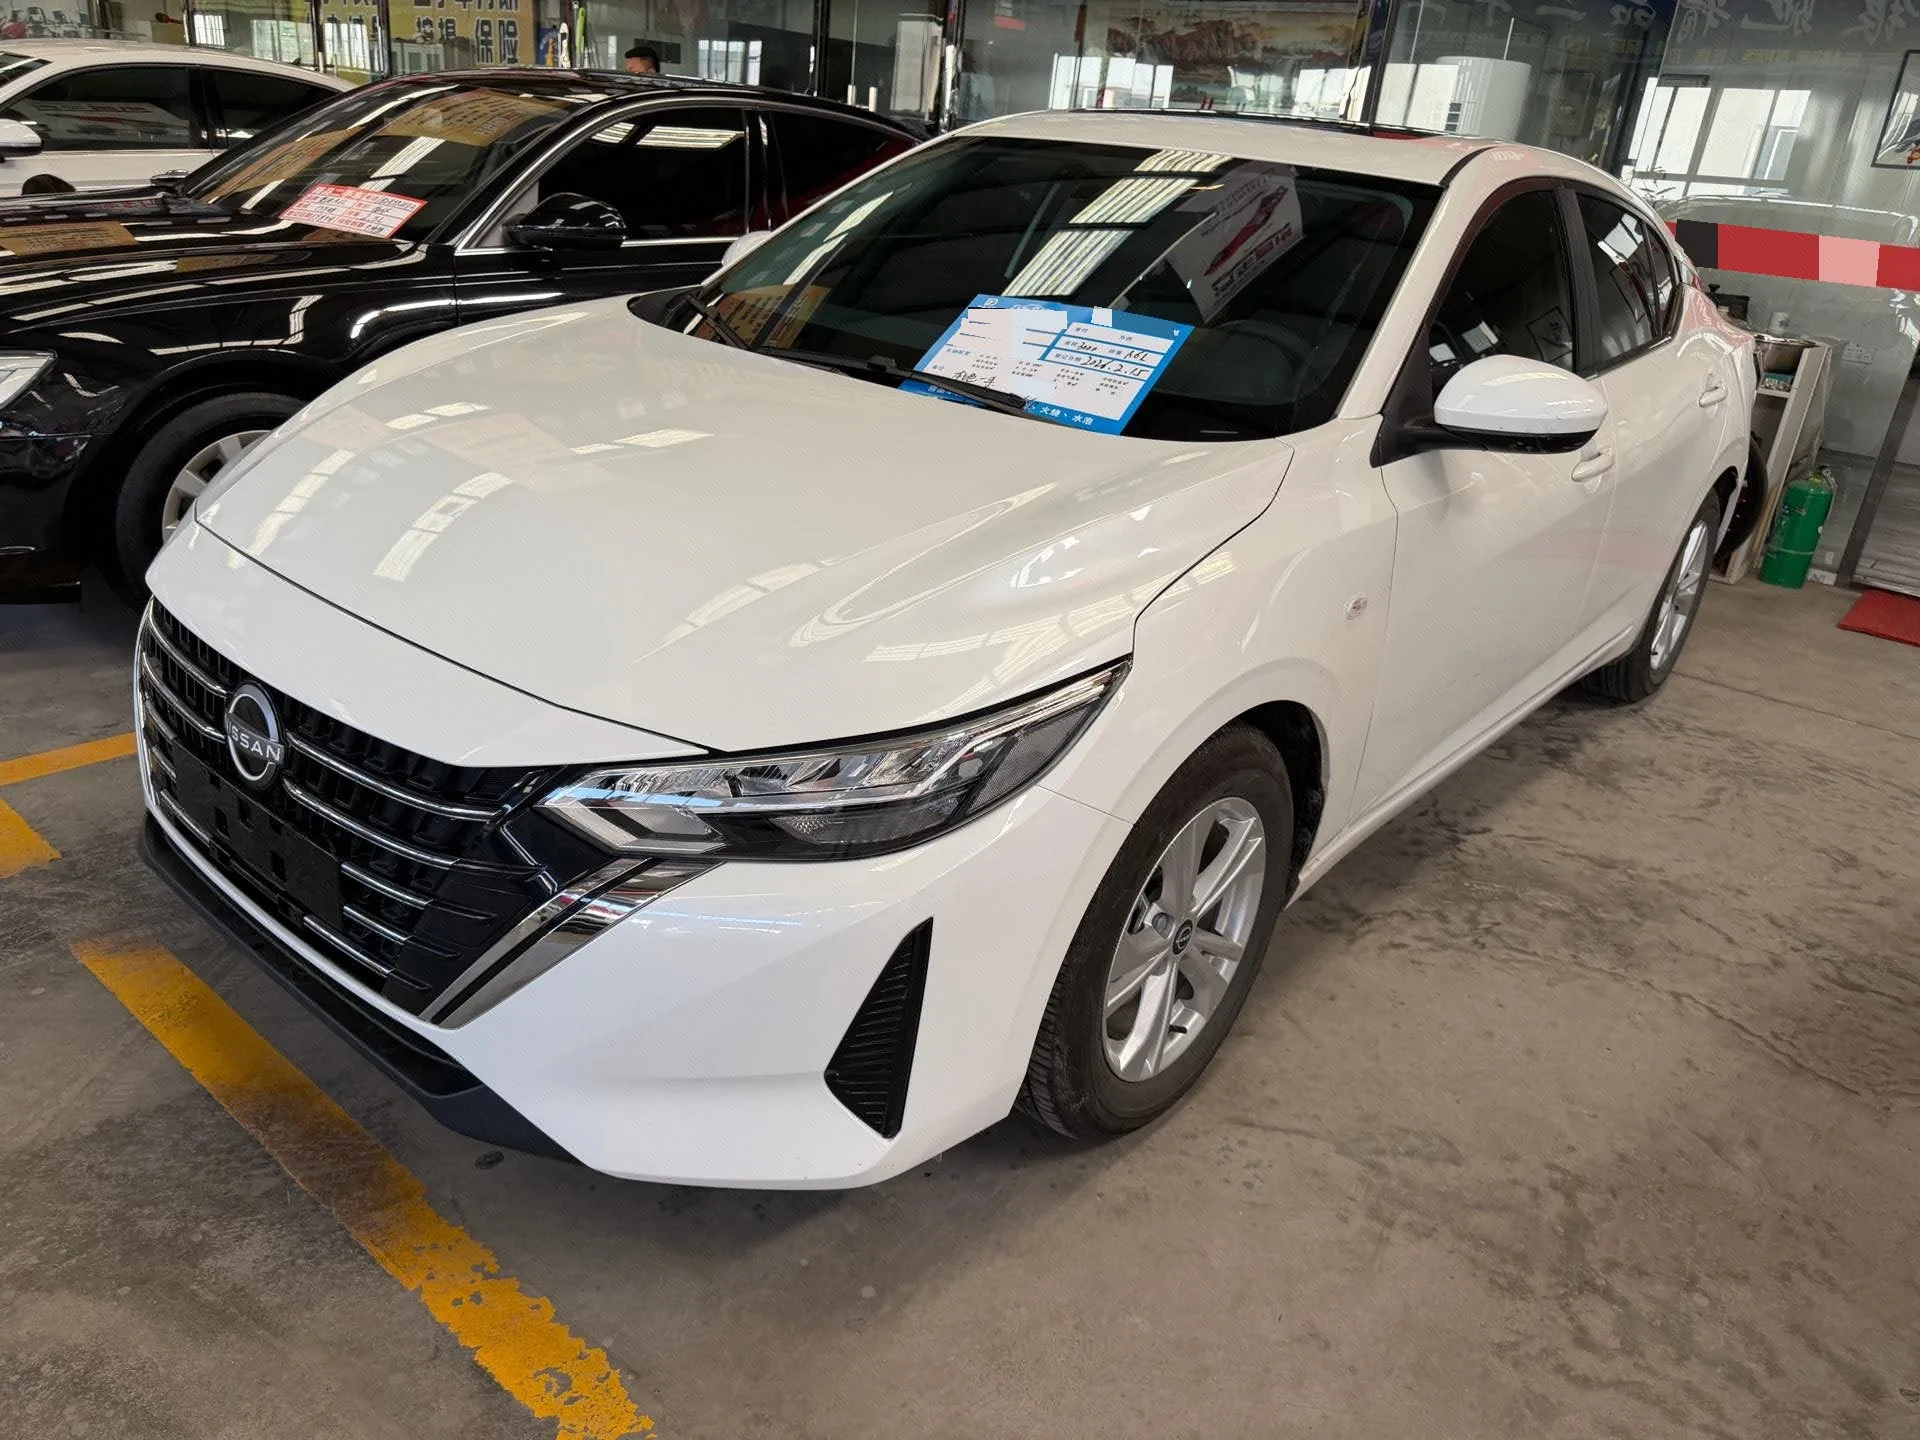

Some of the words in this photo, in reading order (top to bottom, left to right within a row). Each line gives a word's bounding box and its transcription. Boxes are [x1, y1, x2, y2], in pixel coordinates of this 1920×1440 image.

[475, 17, 519, 64] 保险
[1055, 352, 1082, 361] 登记日期
